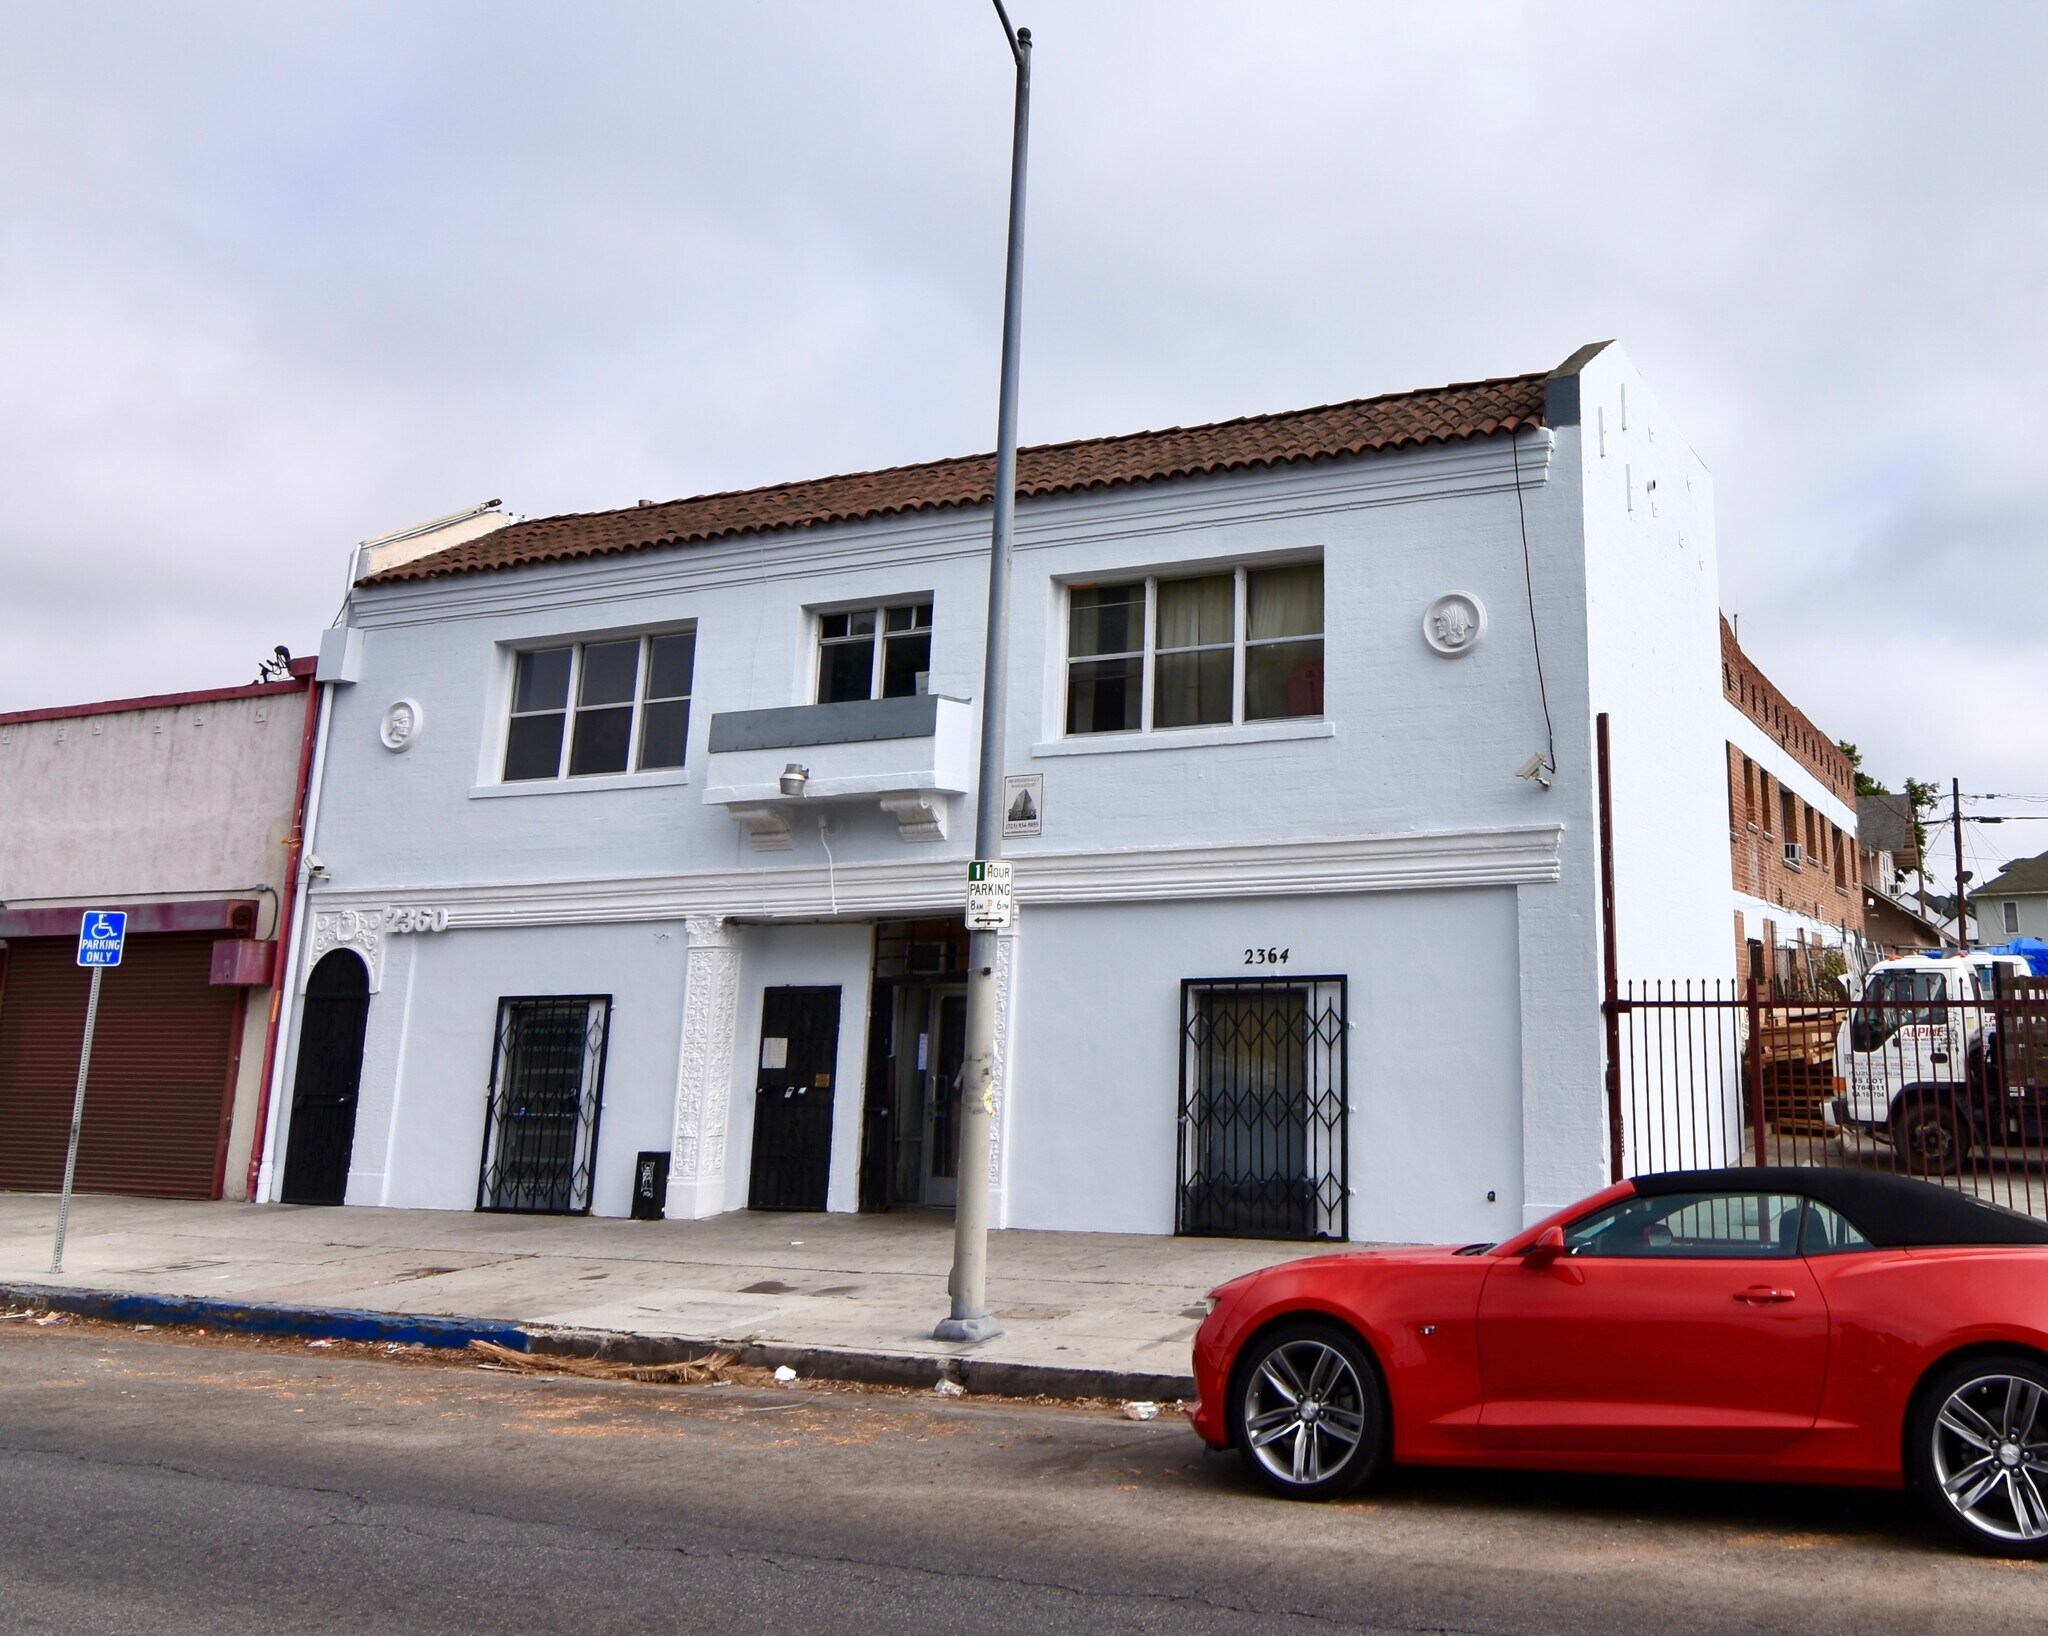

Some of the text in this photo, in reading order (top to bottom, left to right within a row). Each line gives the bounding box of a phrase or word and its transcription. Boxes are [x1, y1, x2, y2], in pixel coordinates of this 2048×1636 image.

[976, 864, 1010, 880] 1 HOUR
[970, 883, 1011, 896] PARKING
[384, 906, 449, 933] 2360
[82, 939, 121, 951] PARKING
[86, 951, 113, 963] ONLY
[1244, 946, 1290, 965] 2364
